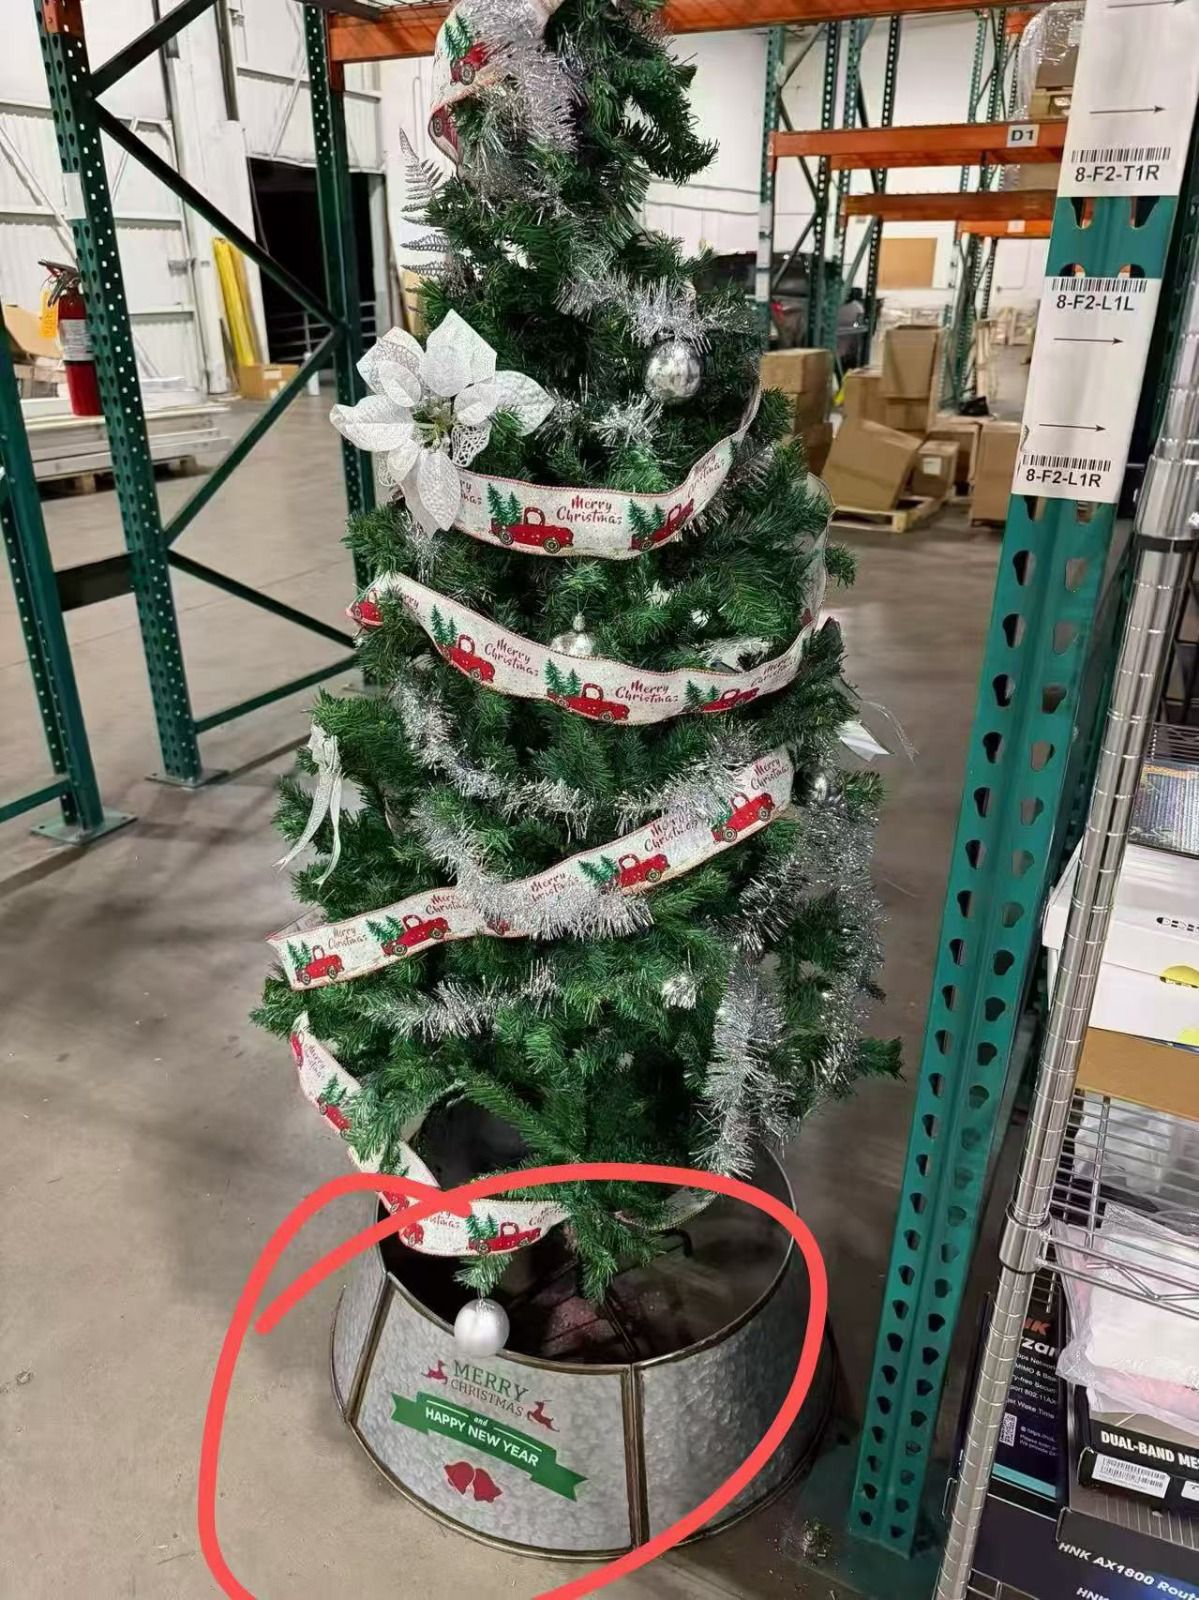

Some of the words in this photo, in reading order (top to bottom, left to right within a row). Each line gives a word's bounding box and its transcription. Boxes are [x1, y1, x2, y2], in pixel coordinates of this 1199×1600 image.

[1011, 129, 1034, 142] D1
[1075, 164, 1160, 183] 8-F2-T1R
[1056, 294, 1135, 311] 8-F2-L1L
[1026, 468, 1102, 488] 8-F2-L1R
[571, 494, 613, 513] Merry
[556, 505, 623, 526] Christmas
[484, 643, 539, 677] Christmas
[496, 638, 531, 665] Merry
[615, 686, 679, 703] Christmas
[631, 680, 669, 695] Merry
[754, 758, 781, 776] Merry
[328, 934, 368, 950] Christmas
[333, 927, 357, 939] Merry
[453, 1359, 529, 1402] MERRY
[450, 1378, 524, 1418] CHRISTMAS
[473, 1416, 489, 1427] and
[425, 1406, 467, 1433] HAPPY
[467, 1425, 501, 1448] NEW
[502, 1440, 539, 1467] YEAR
[1100, 1430, 1175, 1463] DUAL-BAND
[1177, 1452, 1199, 1470] ME
[1058, 1542, 1092, 1562] HNK
[1092, 1556, 1155, 1586] AX1800
